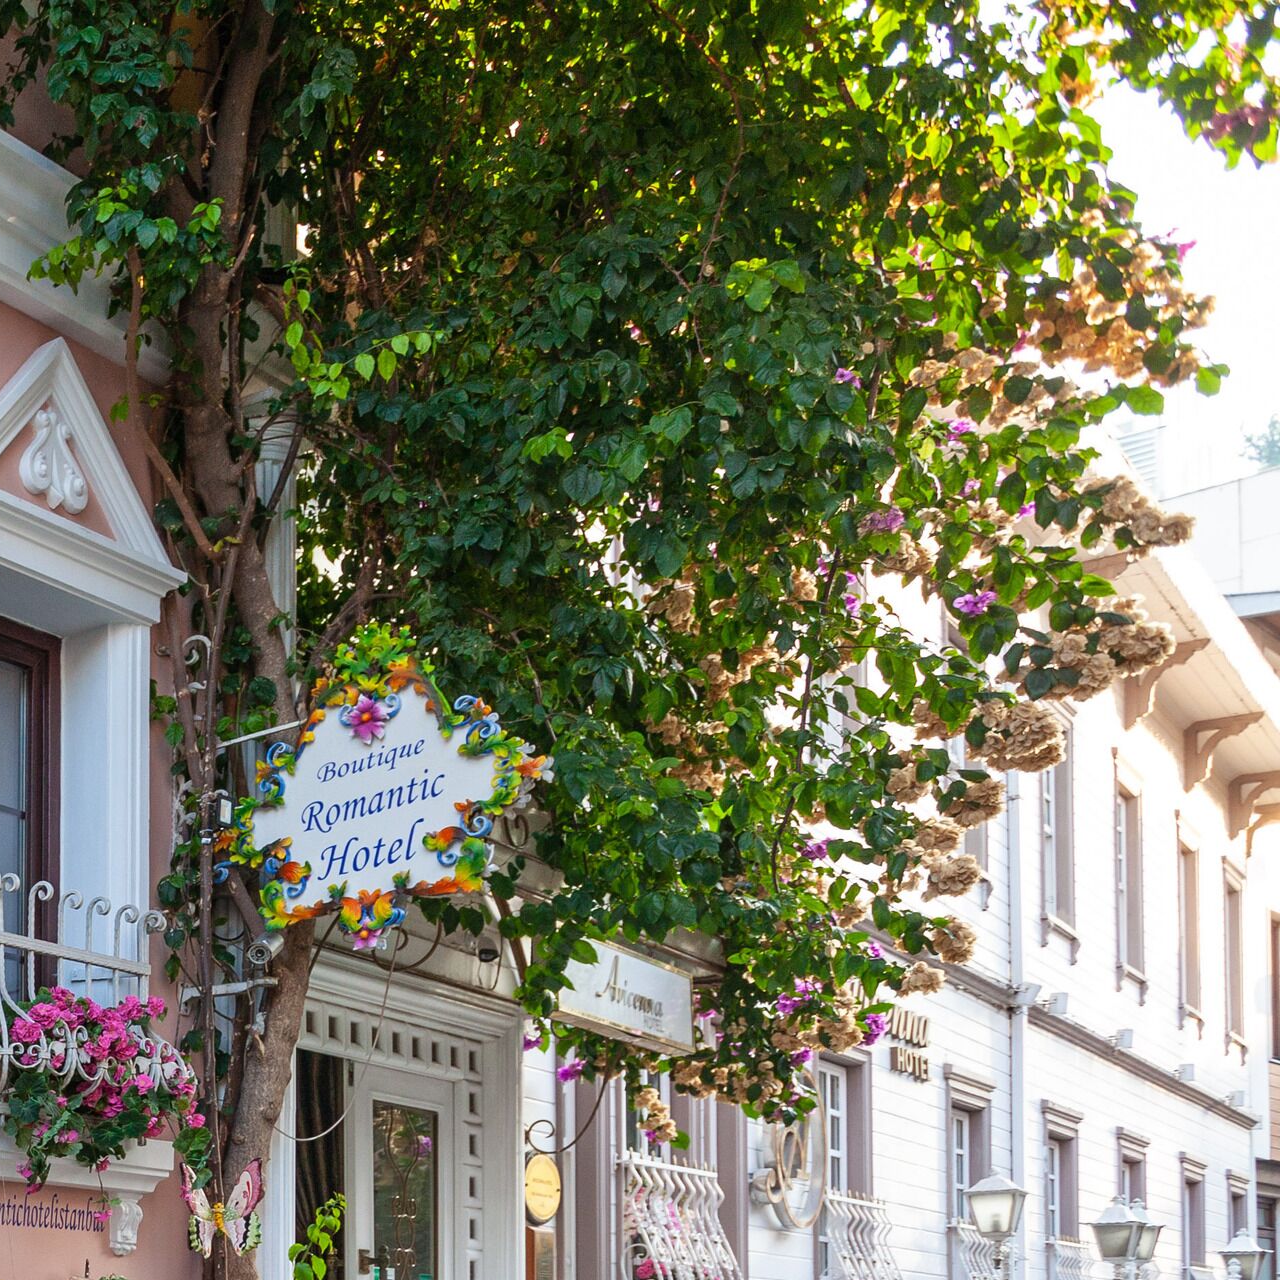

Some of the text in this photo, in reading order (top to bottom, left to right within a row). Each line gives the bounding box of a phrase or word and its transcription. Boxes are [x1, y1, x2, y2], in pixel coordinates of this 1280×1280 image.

[316, 739, 425, 783] Boutique
[300, 768, 446, 834] Romantic
[316, 817, 425, 881] Hotel
[896, 1046, 931, 1081] HOTE
